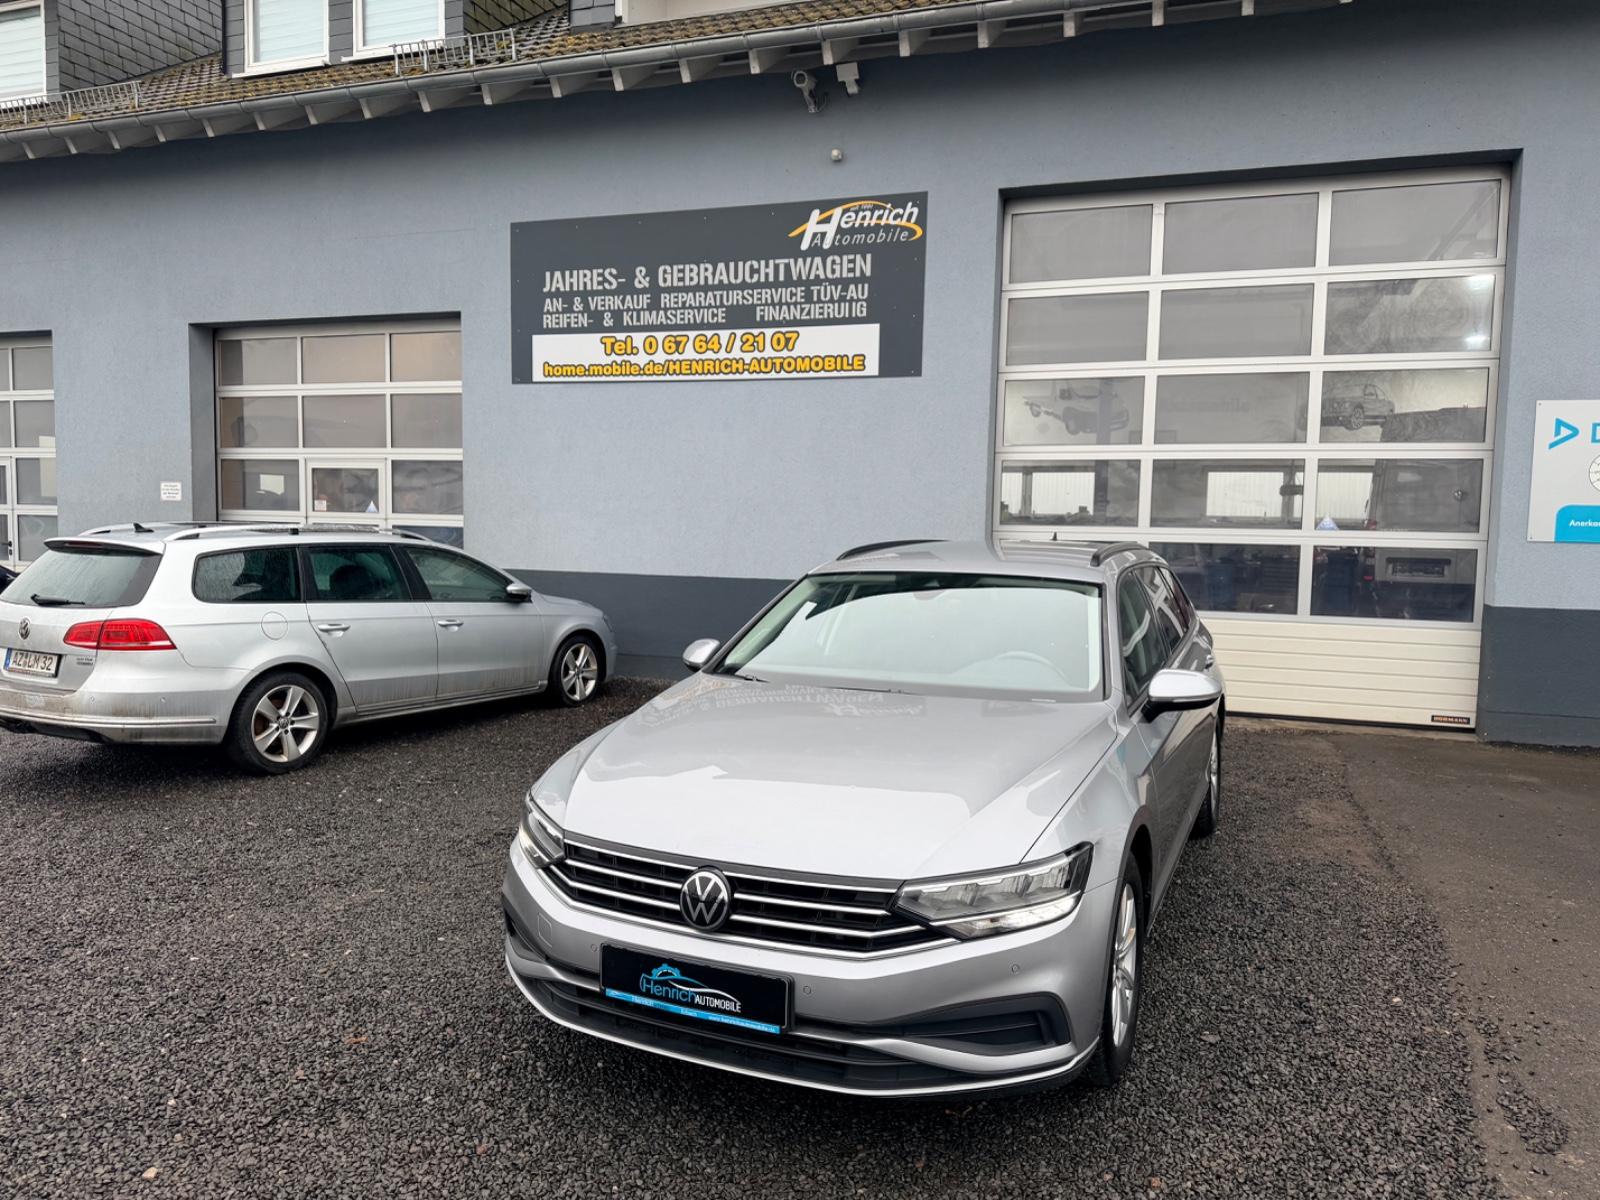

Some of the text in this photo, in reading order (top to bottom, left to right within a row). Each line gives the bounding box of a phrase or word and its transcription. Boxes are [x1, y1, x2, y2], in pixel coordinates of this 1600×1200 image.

[800, 201, 919, 251] Henrich
[542, 253, 872, 292] JAHRES- & GEBRAUCHTWAGEN
[543, 282, 869, 313] AN- & VERKAUF REPARATURSERVICE TÜV-AU
[542, 308, 727, 329] REIFEN- & KLIMASERVICE
[600, 330, 800, 356] Tel. 0 67 64 / 21 07
[543, 354, 866, 378] home.mobile.de/HENRICH-AUTOMOBILE
[40, 655, 54, 671] 32
[642, 977, 697, 1003] Henrich
[694, 994, 742, 1013] AUTOMOBILE
